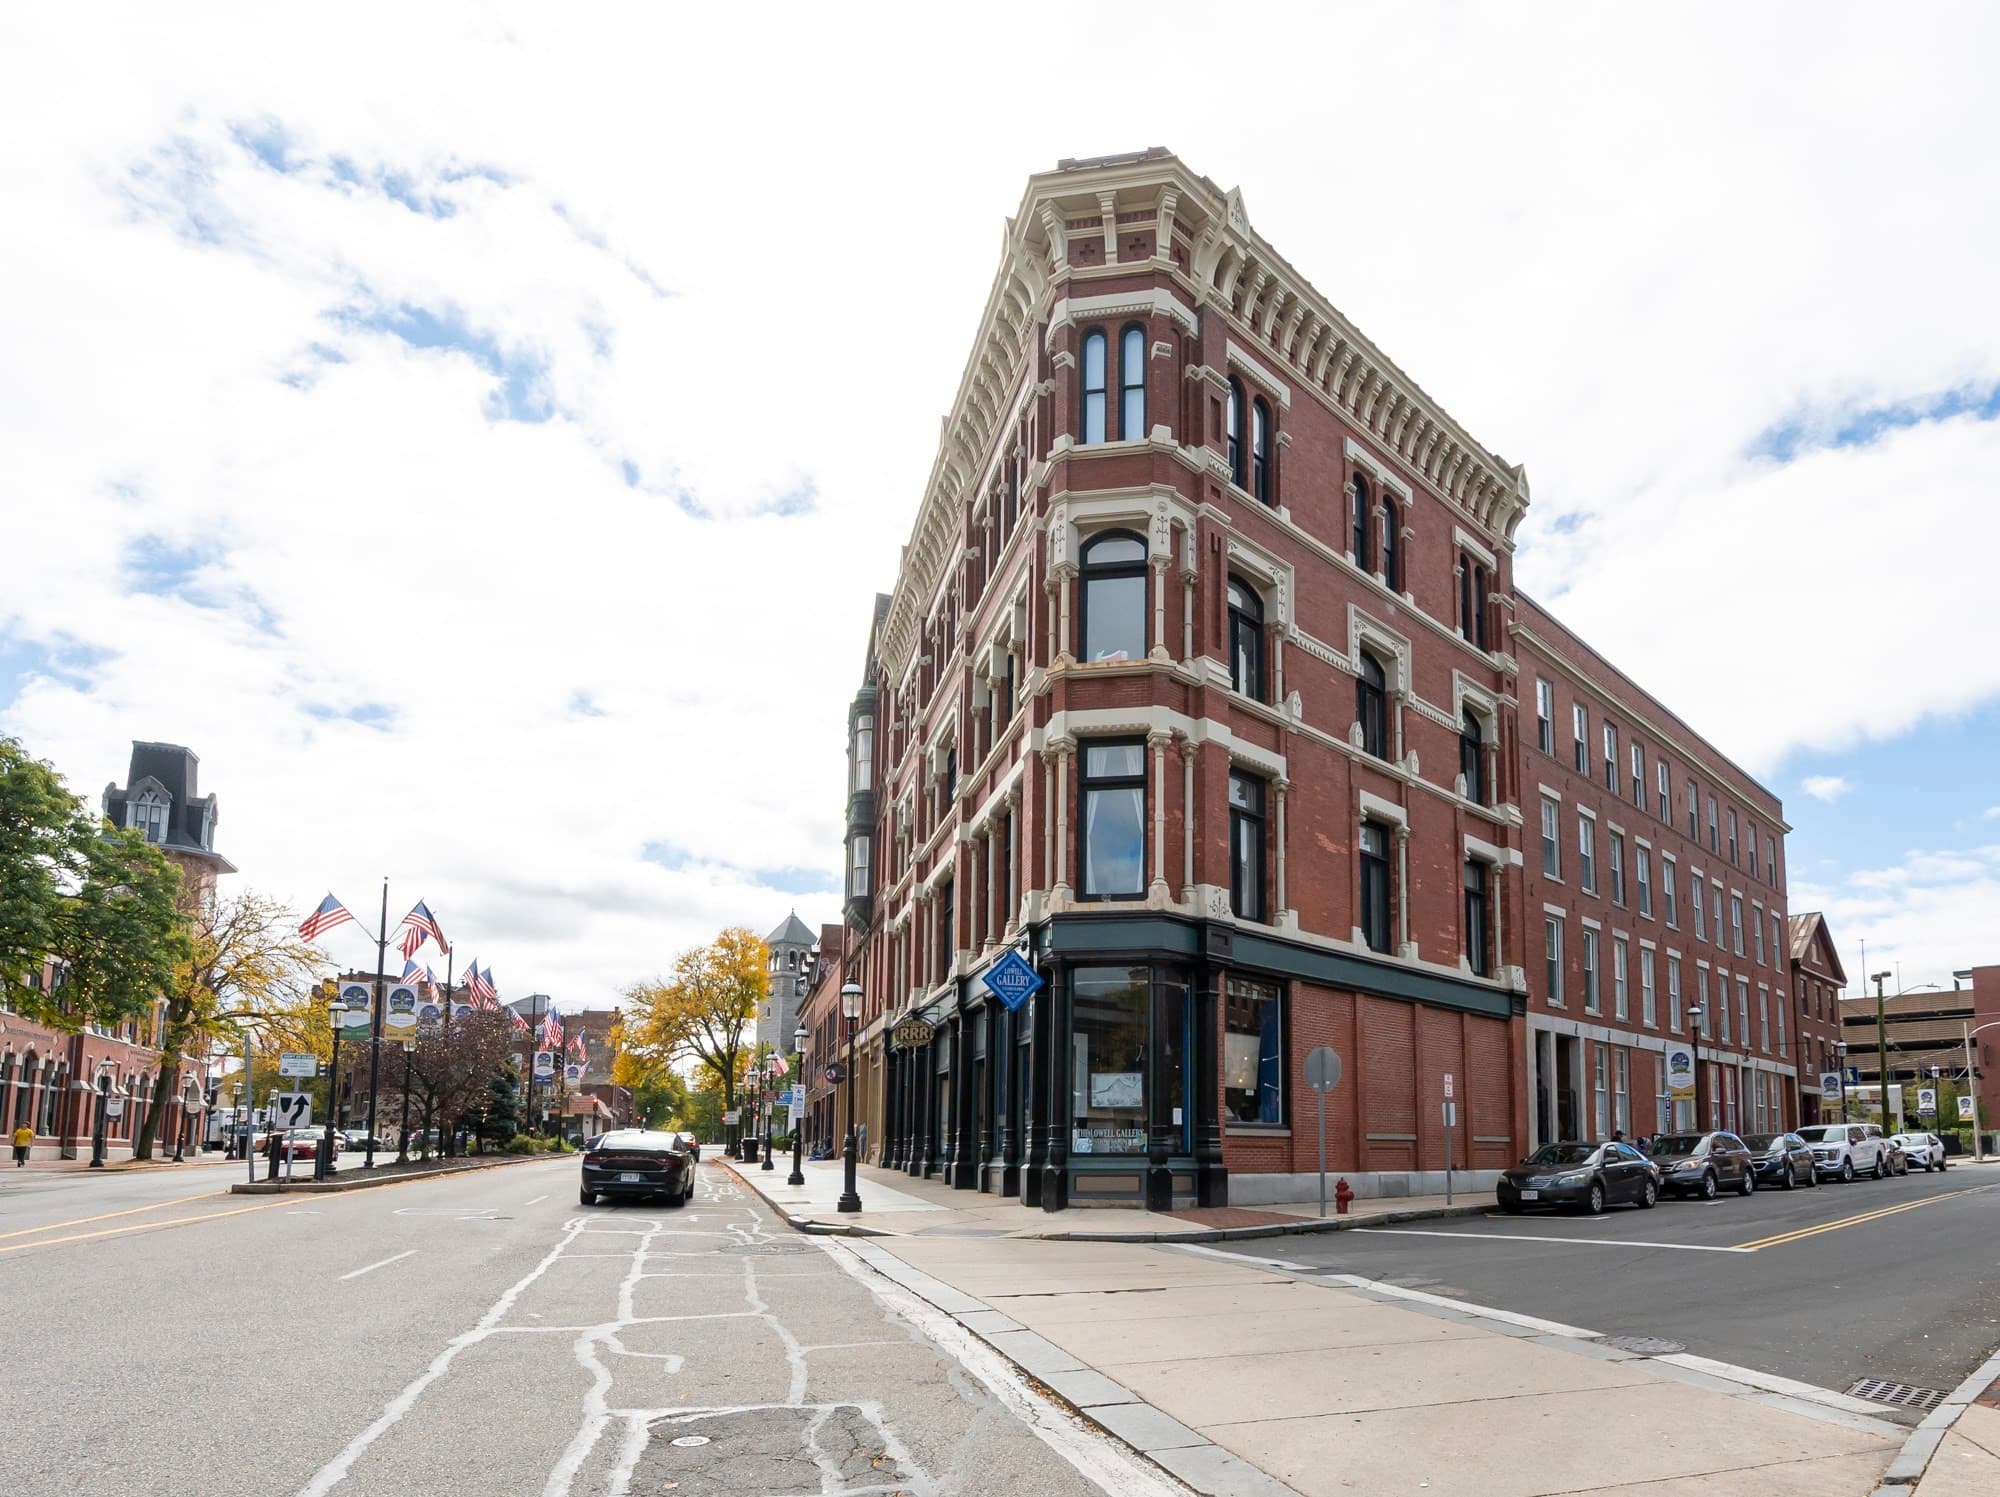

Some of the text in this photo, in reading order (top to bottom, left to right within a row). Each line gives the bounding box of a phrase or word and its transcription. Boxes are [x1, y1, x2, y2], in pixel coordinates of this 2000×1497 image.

[996, 974, 1030, 986] GALLERY
[900, 1026, 929, 1040] RRR
[1091, 1128, 1115, 1137] LOWELL
[1116, 1128, 1144, 1137] GALLERY
